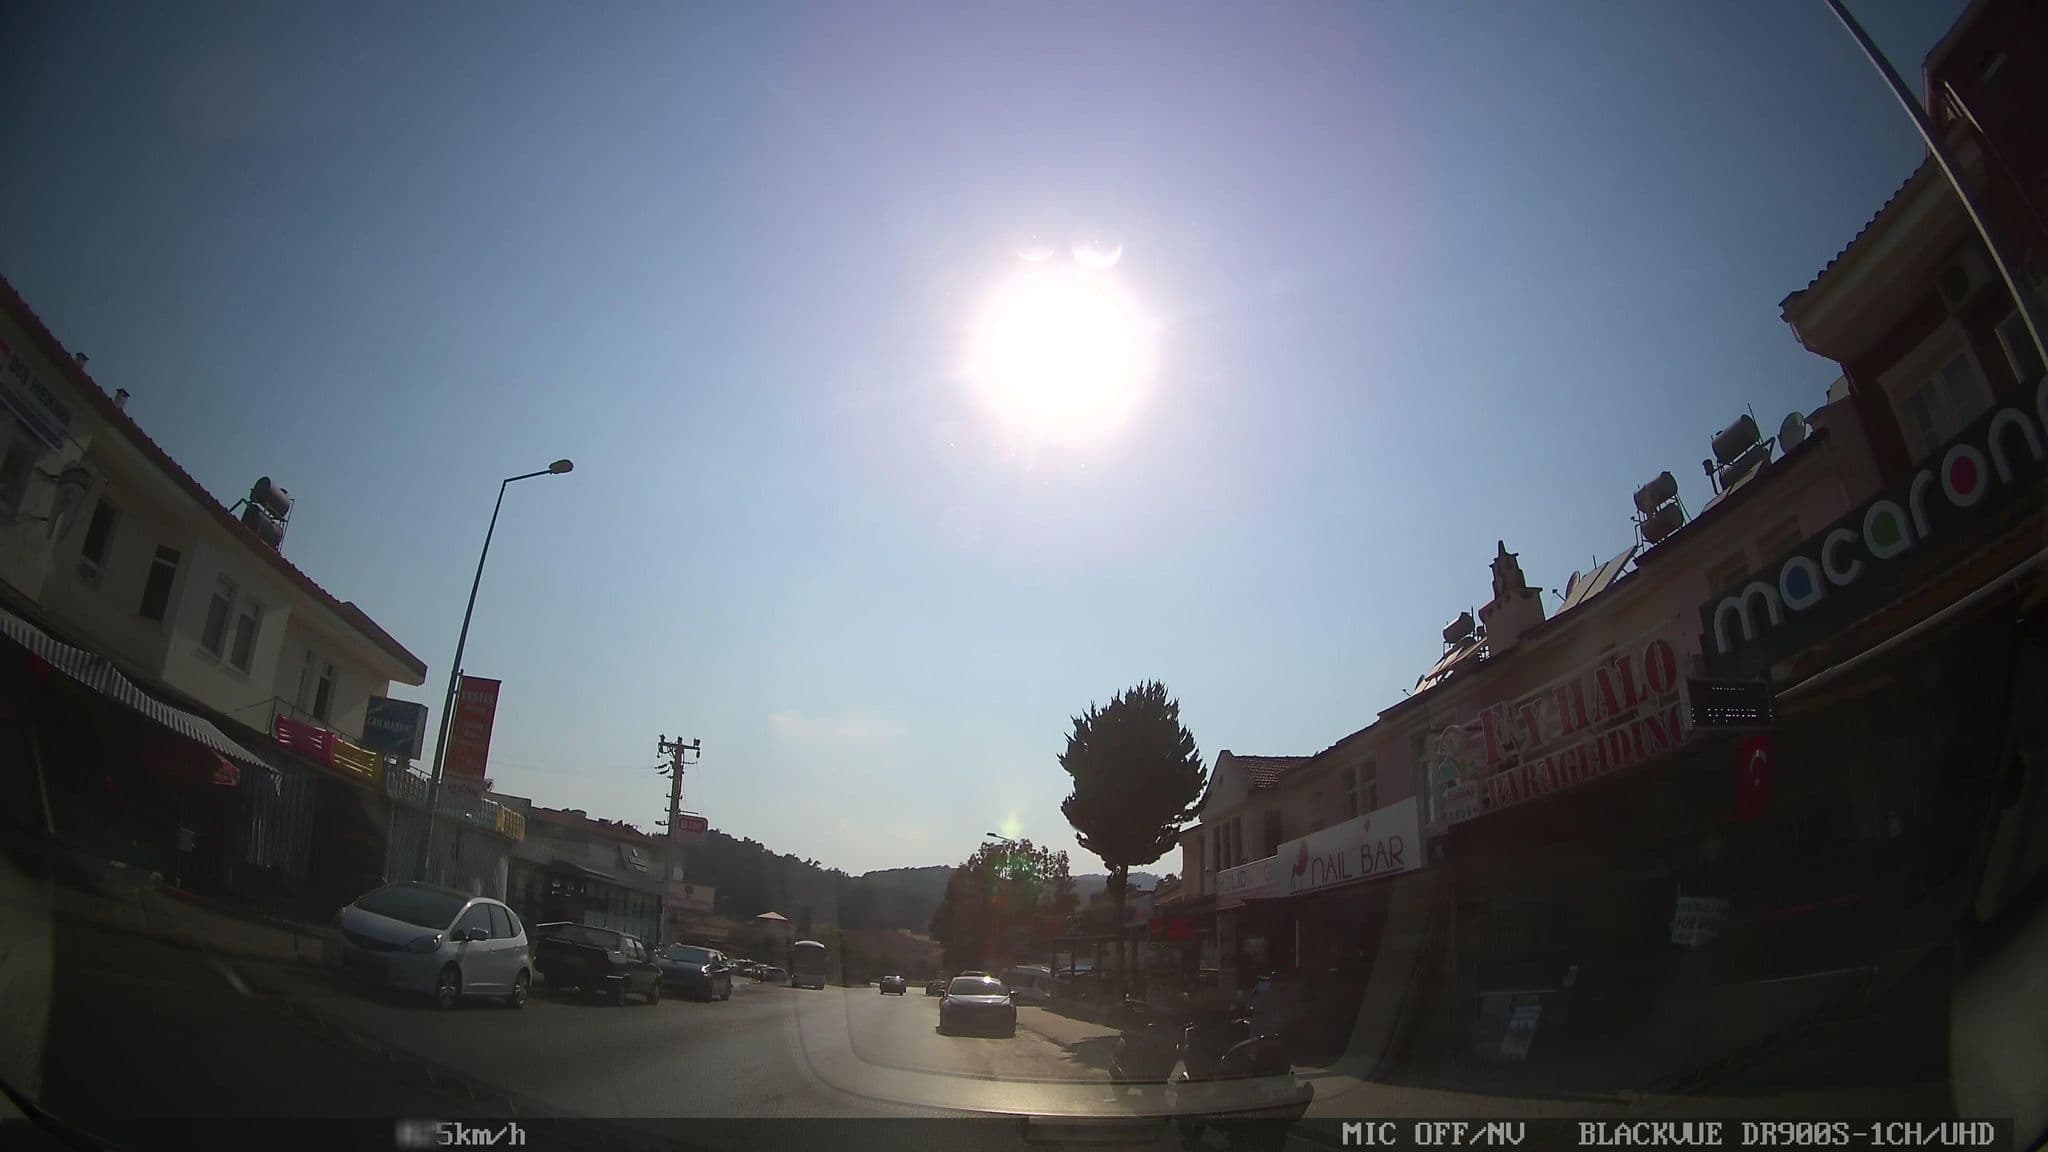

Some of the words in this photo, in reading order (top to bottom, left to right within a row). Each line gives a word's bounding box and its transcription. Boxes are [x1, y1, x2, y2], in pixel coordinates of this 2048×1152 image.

[1713, 375, 2048, 654] macaron
[1311, 851, 1352, 888] NAIL
[1360, 835, 1404, 874] BAR
